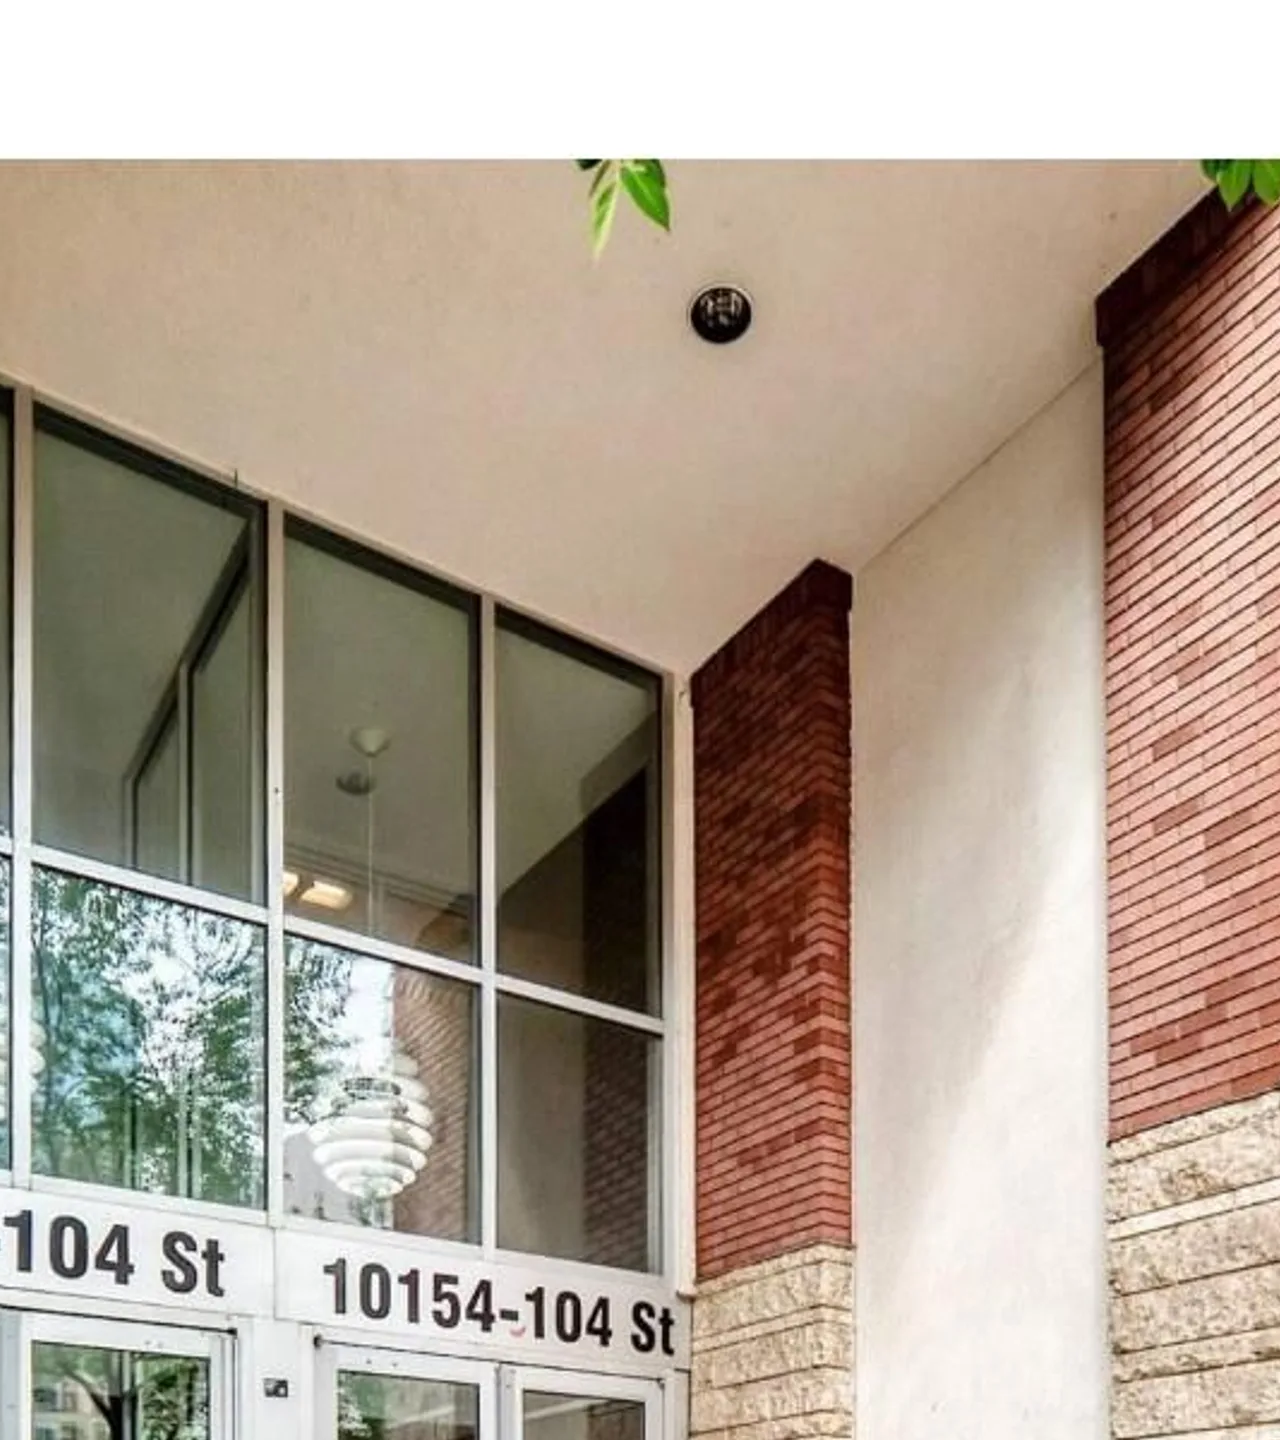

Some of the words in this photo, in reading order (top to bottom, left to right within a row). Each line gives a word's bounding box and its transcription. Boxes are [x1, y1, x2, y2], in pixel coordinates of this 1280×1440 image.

[161, 1231, 225, 1298] St
[323, 1258, 613, 1348] 10154-104
[630, 1300, 675, 1357] St
